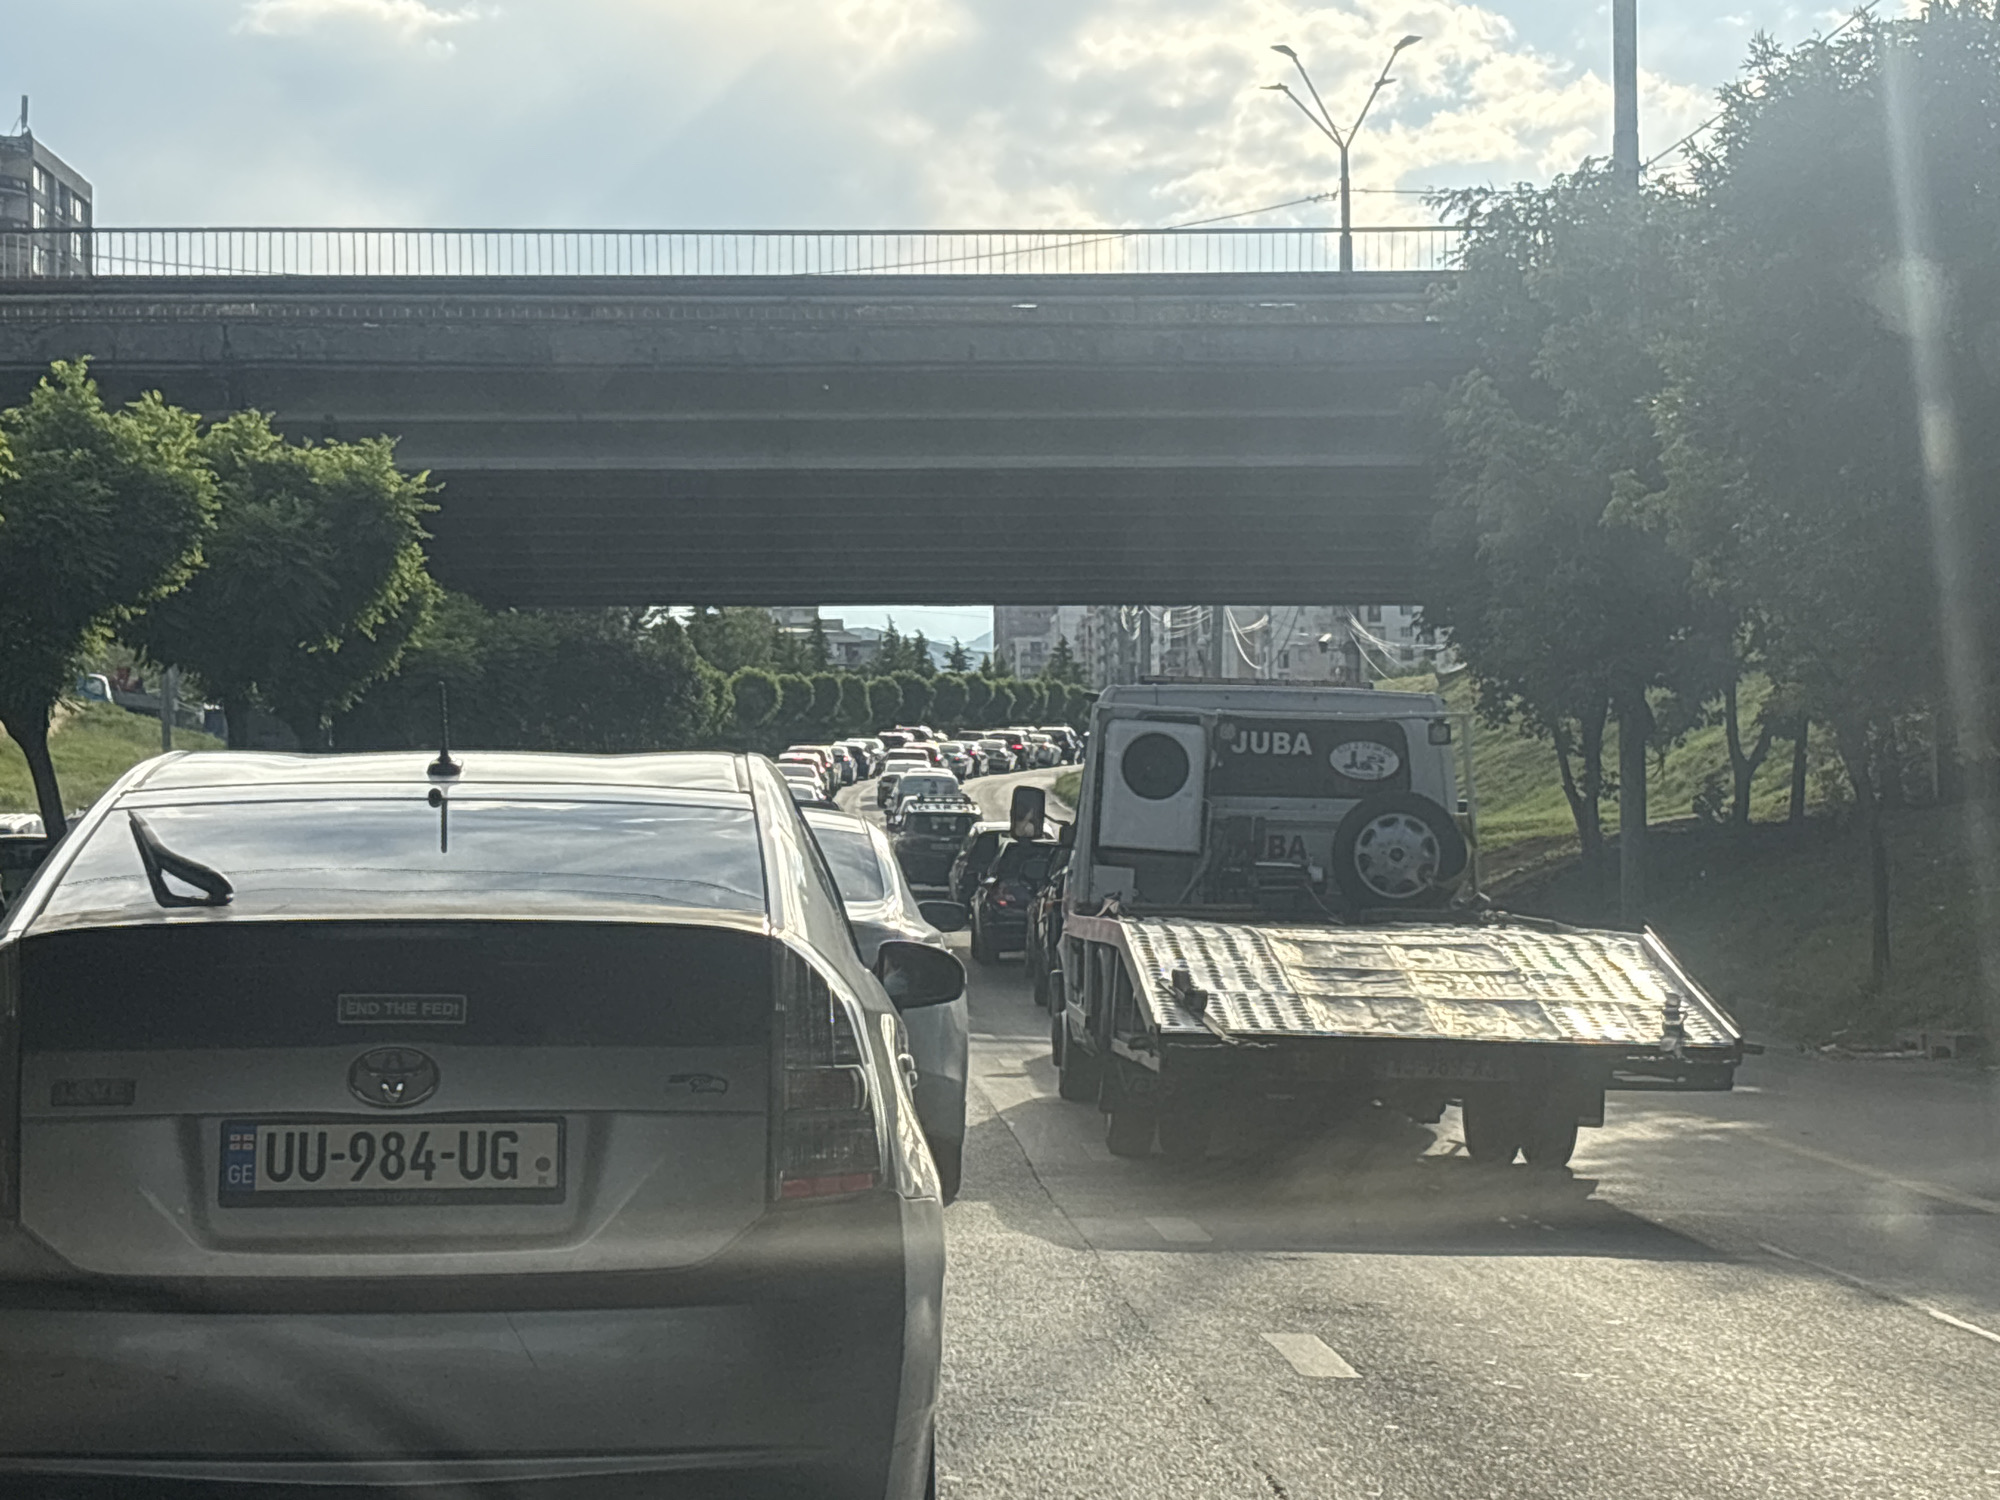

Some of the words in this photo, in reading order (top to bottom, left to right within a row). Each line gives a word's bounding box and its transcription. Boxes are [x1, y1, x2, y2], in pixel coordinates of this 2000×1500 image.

[1231, 731, 1313, 756] JUBA
[1268, 834, 1308, 861] BA
[346, 1000, 380, 1015] END
[384, 1001, 417, 1015] THE
[421, 1002, 460, 1016] FED!
[264, 1130, 519, 1183] UU-984-UG
[227, 1164, 253, 1185] GE
